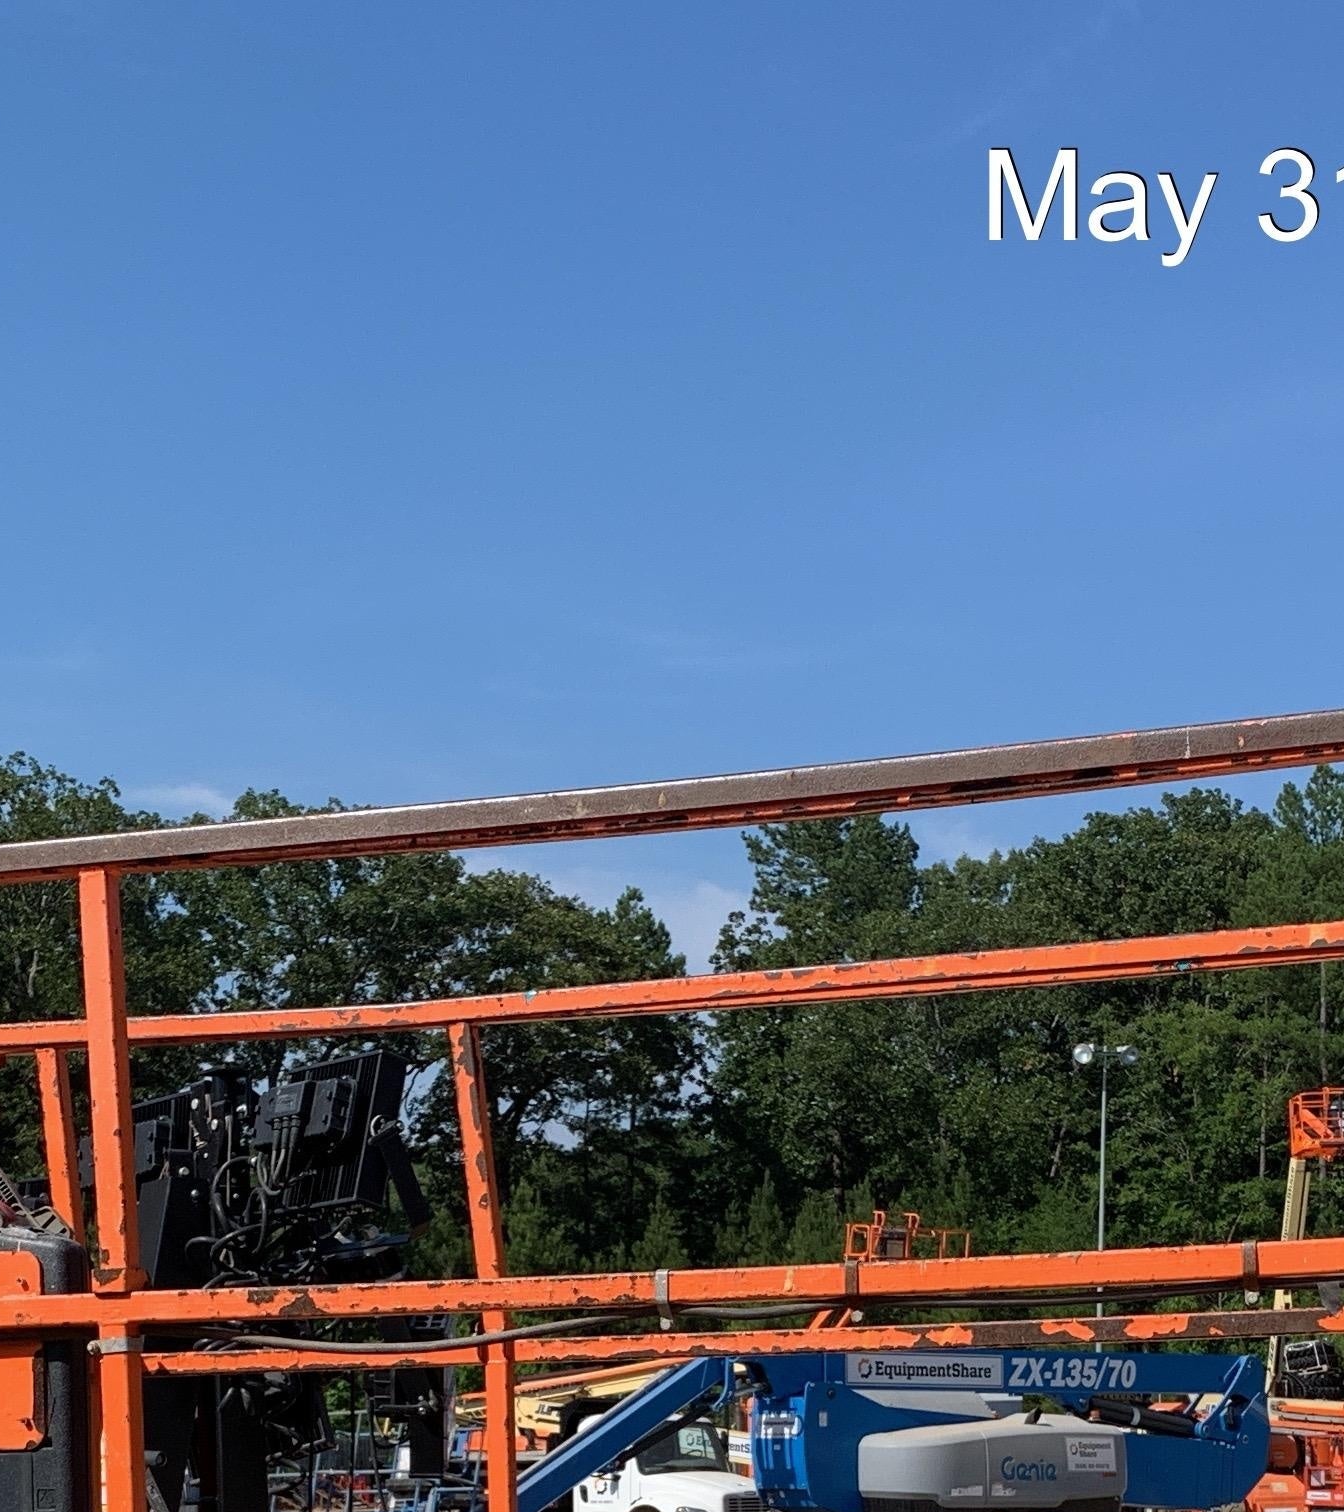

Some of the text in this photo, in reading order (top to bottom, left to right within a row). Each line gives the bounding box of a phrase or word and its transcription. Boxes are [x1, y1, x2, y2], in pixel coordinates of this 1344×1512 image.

[875, 1360, 992, 1380] EquipmentShare
[1008, 1356, 1137, 1390] ZX-135/70
[1001, 1455, 1057, 1481] Genie
